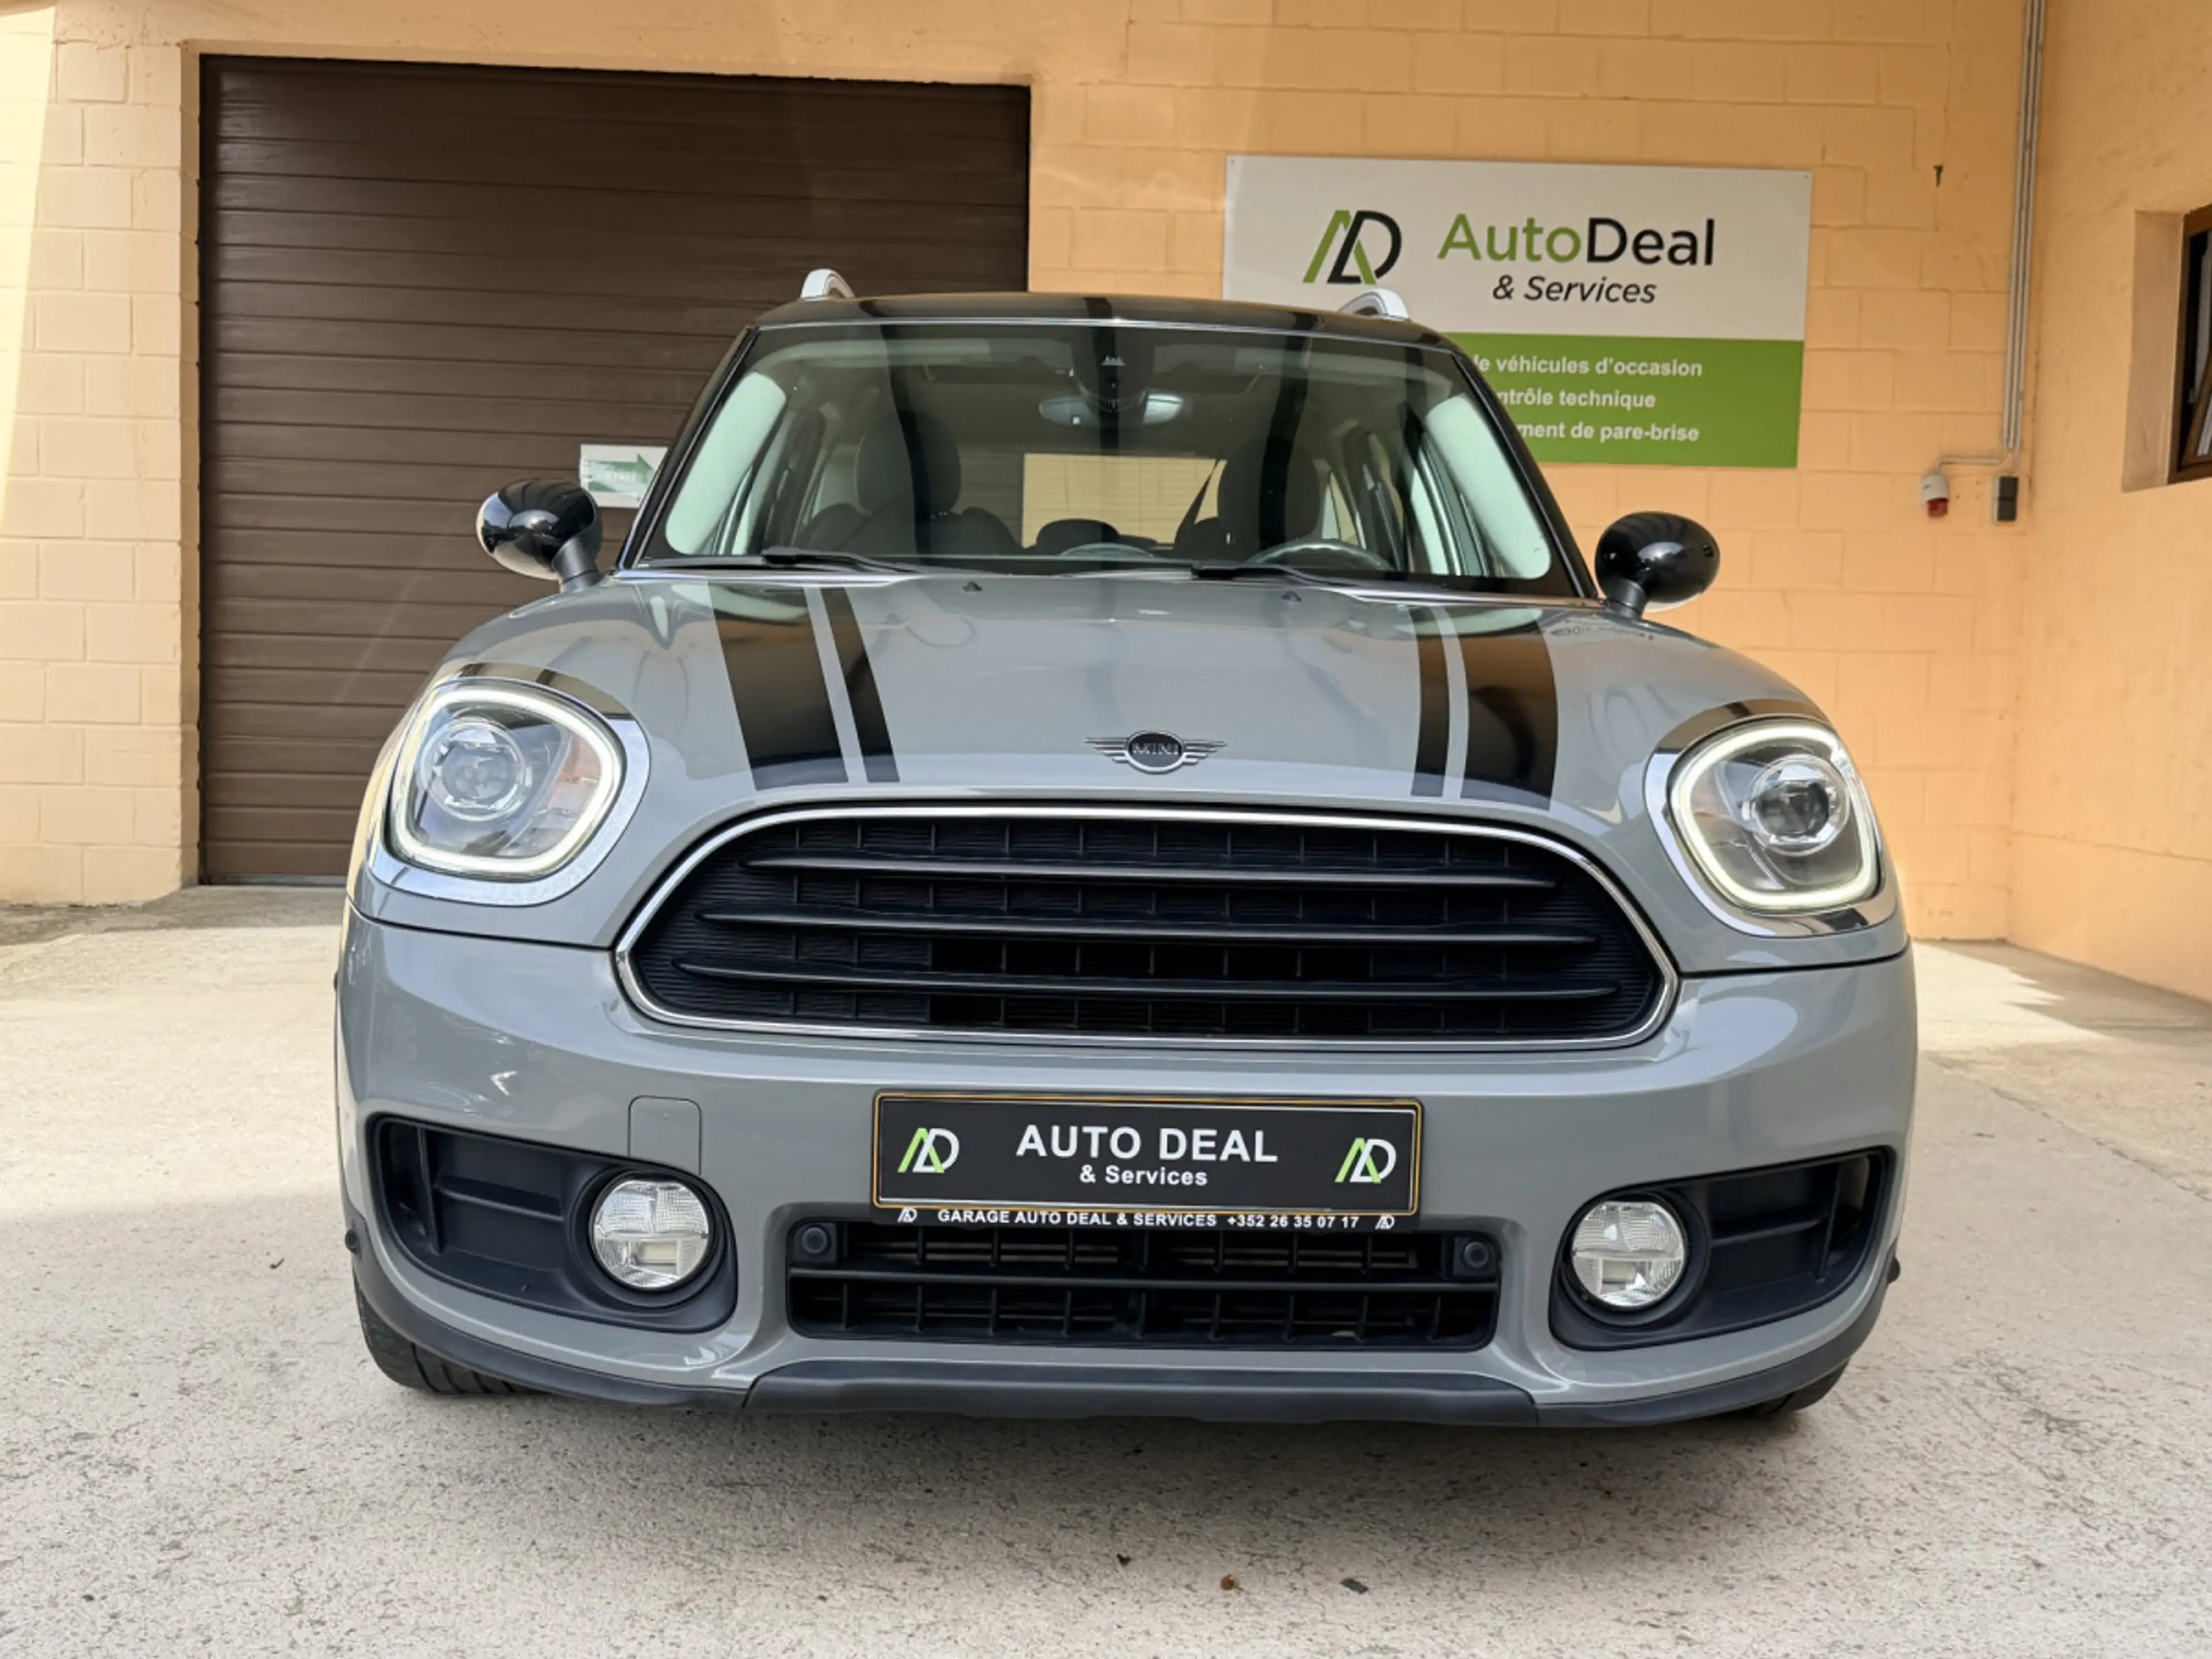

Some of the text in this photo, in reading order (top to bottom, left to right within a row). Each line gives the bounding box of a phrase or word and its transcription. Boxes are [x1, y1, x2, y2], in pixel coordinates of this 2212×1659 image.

[1437, 213, 1715, 266] AutoDeal
[1493, 274, 1657, 304] & Services
[1495, 355, 1590, 374] véhicules
[1595, 357, 1703, 377] d'occasion
[1497, 388, 1656, 411] ntrôle technique
[1517, 421, 1700, 444] ment de pare-brise
[1132, 742, 1180, 755] MINI
[1015, 1124, 1279, 1162] AUTO DEAL
[1079, 1164, 1208, 1185] & Services
[937, 1209, 1360, 1229] GARAGE AUTO DEAL & SERVICES +352 26 35 07 17
